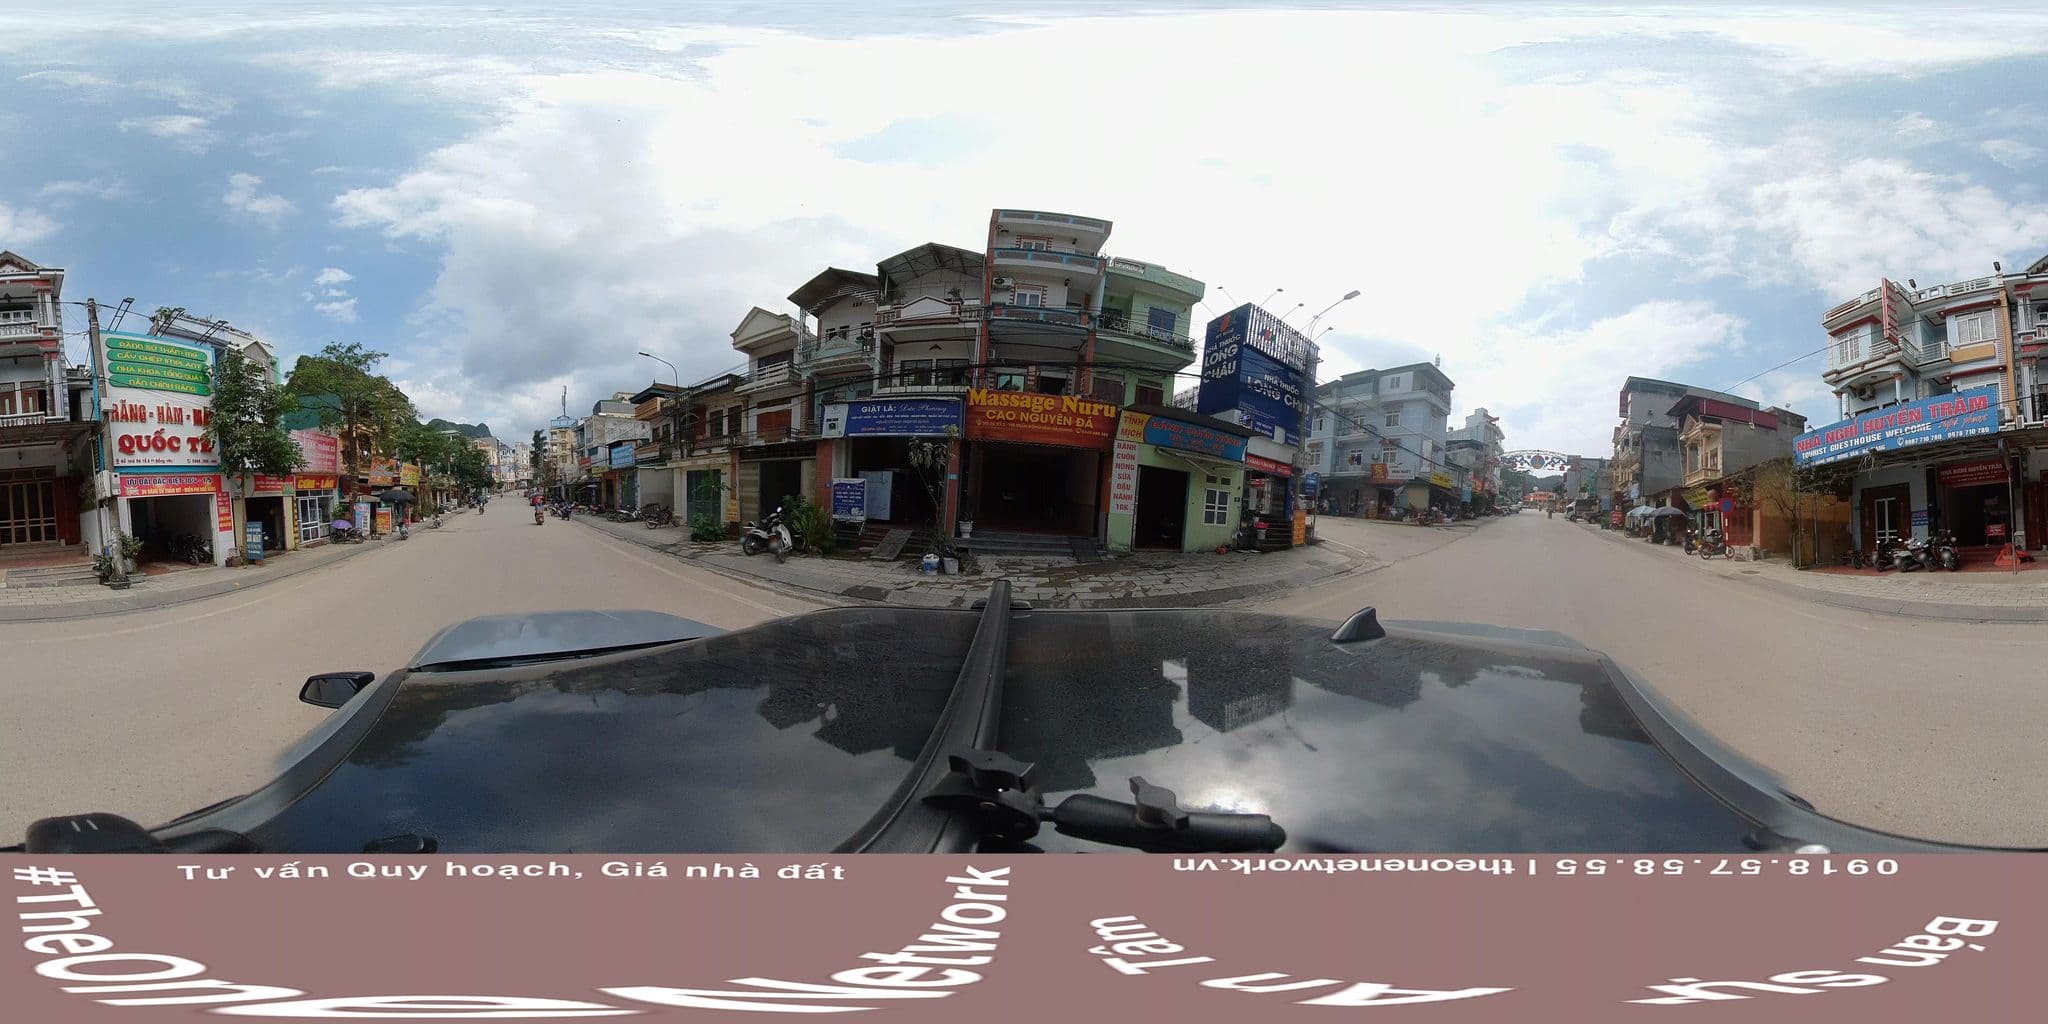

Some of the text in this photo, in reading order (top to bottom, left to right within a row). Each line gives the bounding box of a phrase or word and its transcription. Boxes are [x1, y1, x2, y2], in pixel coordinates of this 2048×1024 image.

[1219, 332, 1241, 347] THUỐC
[1204, 344, 1239, 367] LONG
[1203, 361, 1237, 383] CHÂU
[1247, 376, 1281, 401] LONG
[1263, 373, 1300, 396] NHÀ THUỐC
[111, 399, 147, 423] RĂNG
[156, 402, 184, 425] HÀM
[861, 404, 881, 414] GIẶT
[968, 387, 1117, 418] Massage Nuru
[985, 409, 1016, 421] CAO
[1020, 412, 1072, 426] NGUYÊN
[1076, 416, 1093, 429] ĐÁ
[1797, 433, 1822, 452] NHÀ
[1825, 417, 1858, 444] NGHỈ
[1863, 403, 1922, 435] HUYỀN
[1928, 395, 1989, 420] TRÂM
[118, 428, 181, 455] QUỐC
[1116, 441, 1137, 451] BÁNH
[1802, 447, 1827, 460] TOURIST
[1830, 432, 1882, 452] GUESTHOUSE
[1885, 422, 1932, 438] WELCOME
[1115, 462, 1135, 471] NÓNG
[1116, 503, 1129, 511] 10K
